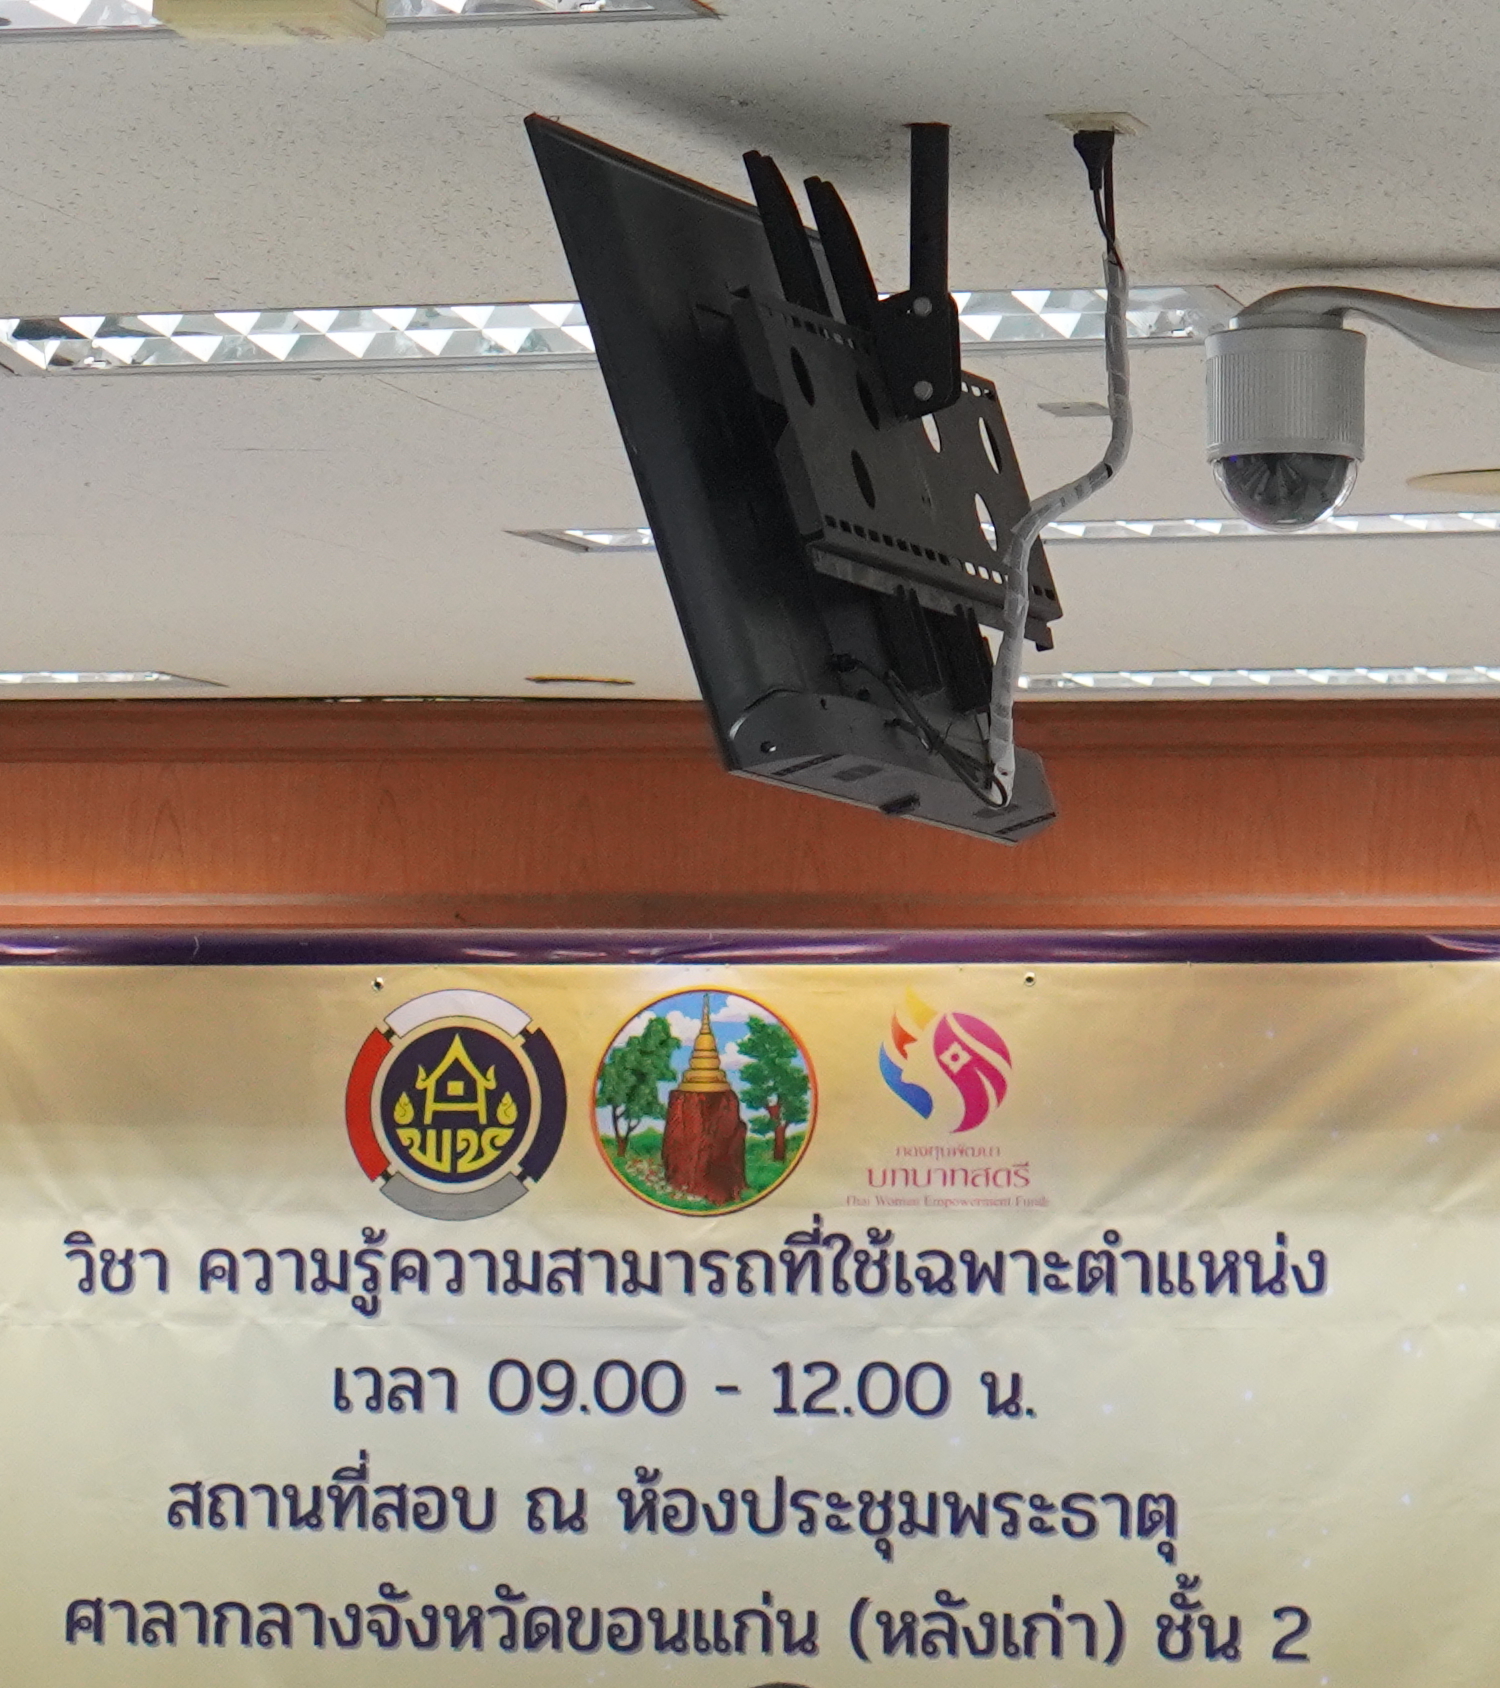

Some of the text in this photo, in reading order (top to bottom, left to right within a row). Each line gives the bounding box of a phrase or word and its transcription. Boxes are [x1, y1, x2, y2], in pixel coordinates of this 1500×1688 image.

[867, 1161, 1032, 1188] บทบาทสตรี
[63, 1213, 1329, 1318] วิชา ความรู้ความสามารถที่ใช้เฉพาะตำแหน่ง
[333, 1356, 1037, 1419] เวลา 09.00 - 12.00 น.
[166, 1448, 1179, 1565] สถานที่สอบ ณ ห้องประชุมพระธาตุ
[64, 1572, 1314, 1667] ศาลากลางจังหวัดขอนแก่น (หลังเก่า) ชั้น 2
